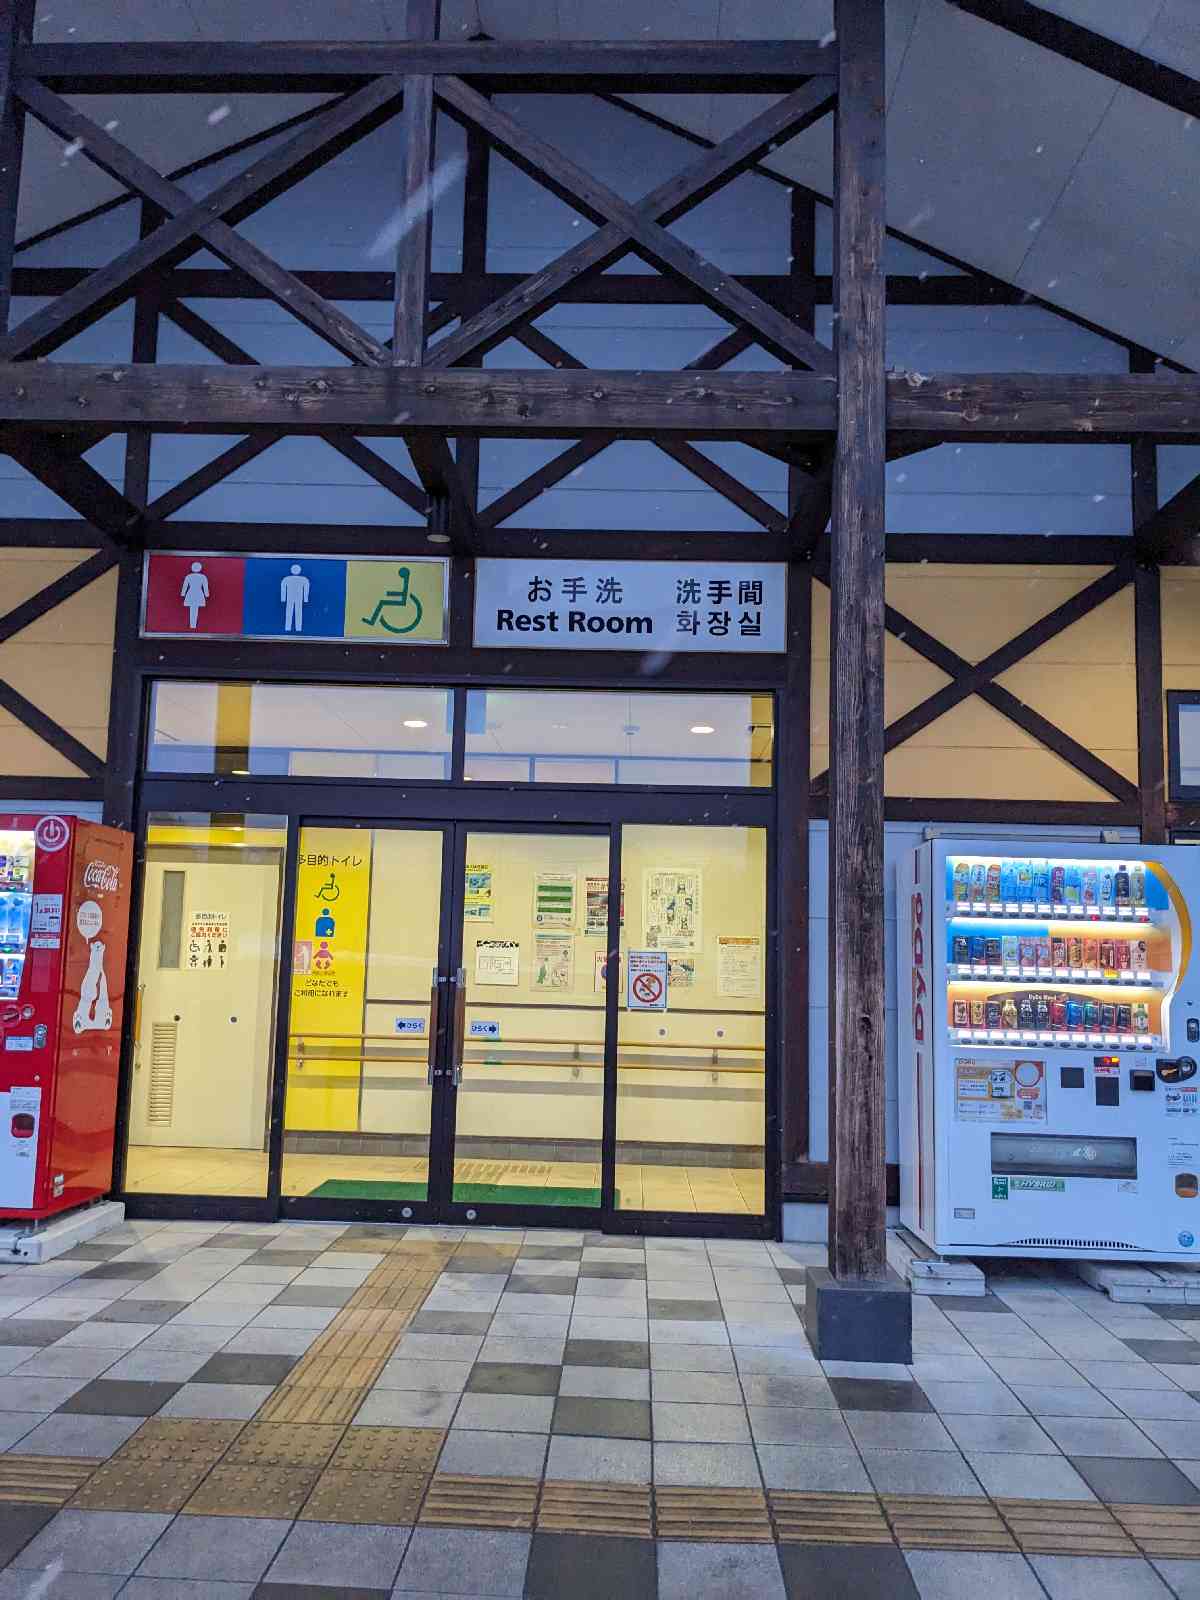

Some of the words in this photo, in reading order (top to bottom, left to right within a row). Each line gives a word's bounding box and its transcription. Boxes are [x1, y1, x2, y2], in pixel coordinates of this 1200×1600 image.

[527, 574, 623, 604] お手洗
[675, 577, 763, 606] 洗手間
[496, 608, 559, 632] Rest
[568, 610, 653, 634] Room
[675, 609, 762, 637] 화장실
